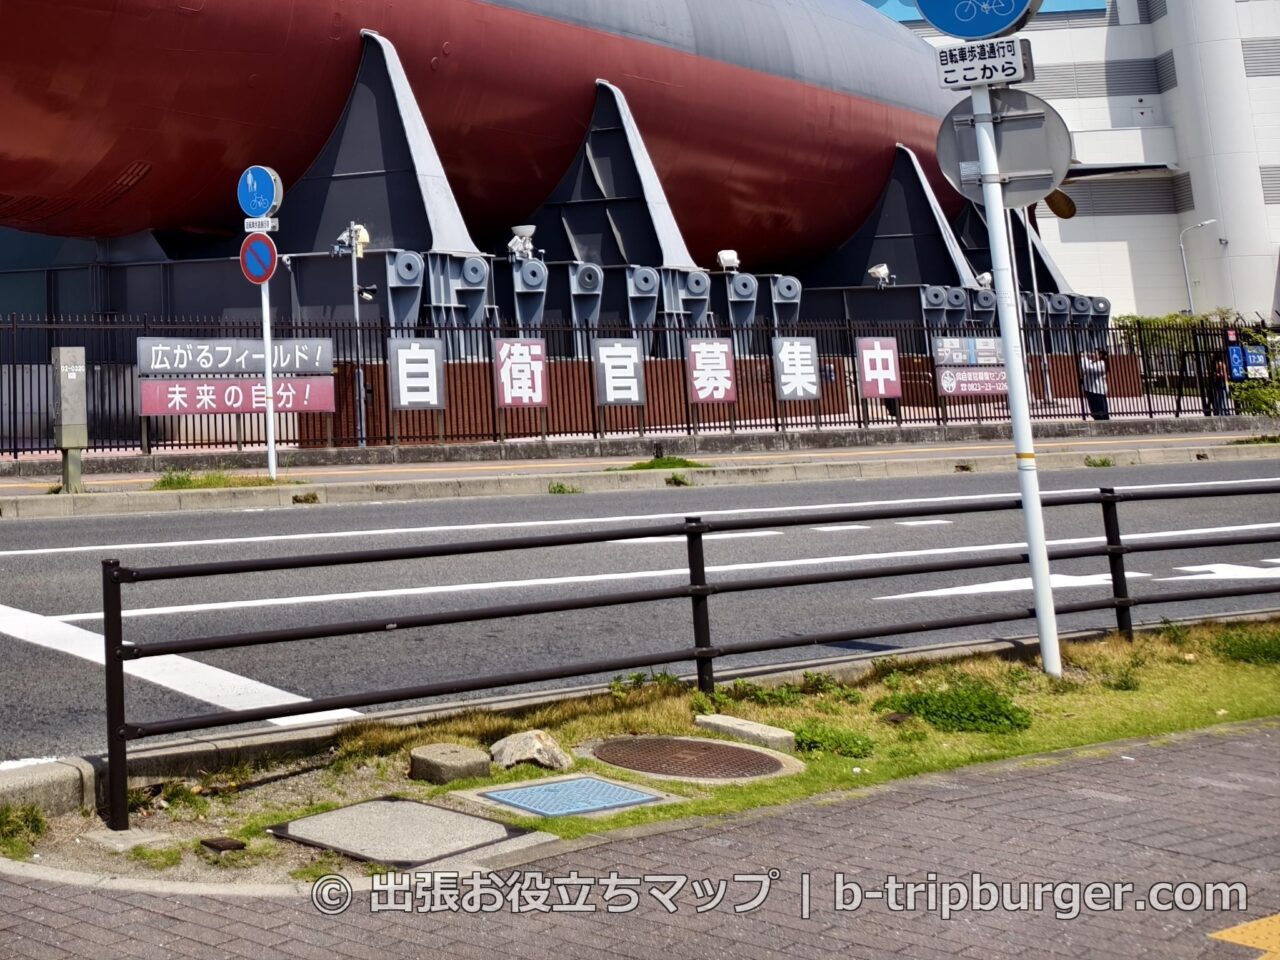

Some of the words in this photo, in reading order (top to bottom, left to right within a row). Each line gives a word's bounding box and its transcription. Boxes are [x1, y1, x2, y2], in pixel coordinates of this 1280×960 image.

[939, 40, 1016, 66] 自転車歩道通行可
[944, 61, 1017, 84] ここから
[151, 343, 322, 369] 広がるフィールド!
[167, 383, 310, 411] 未来の自分!
